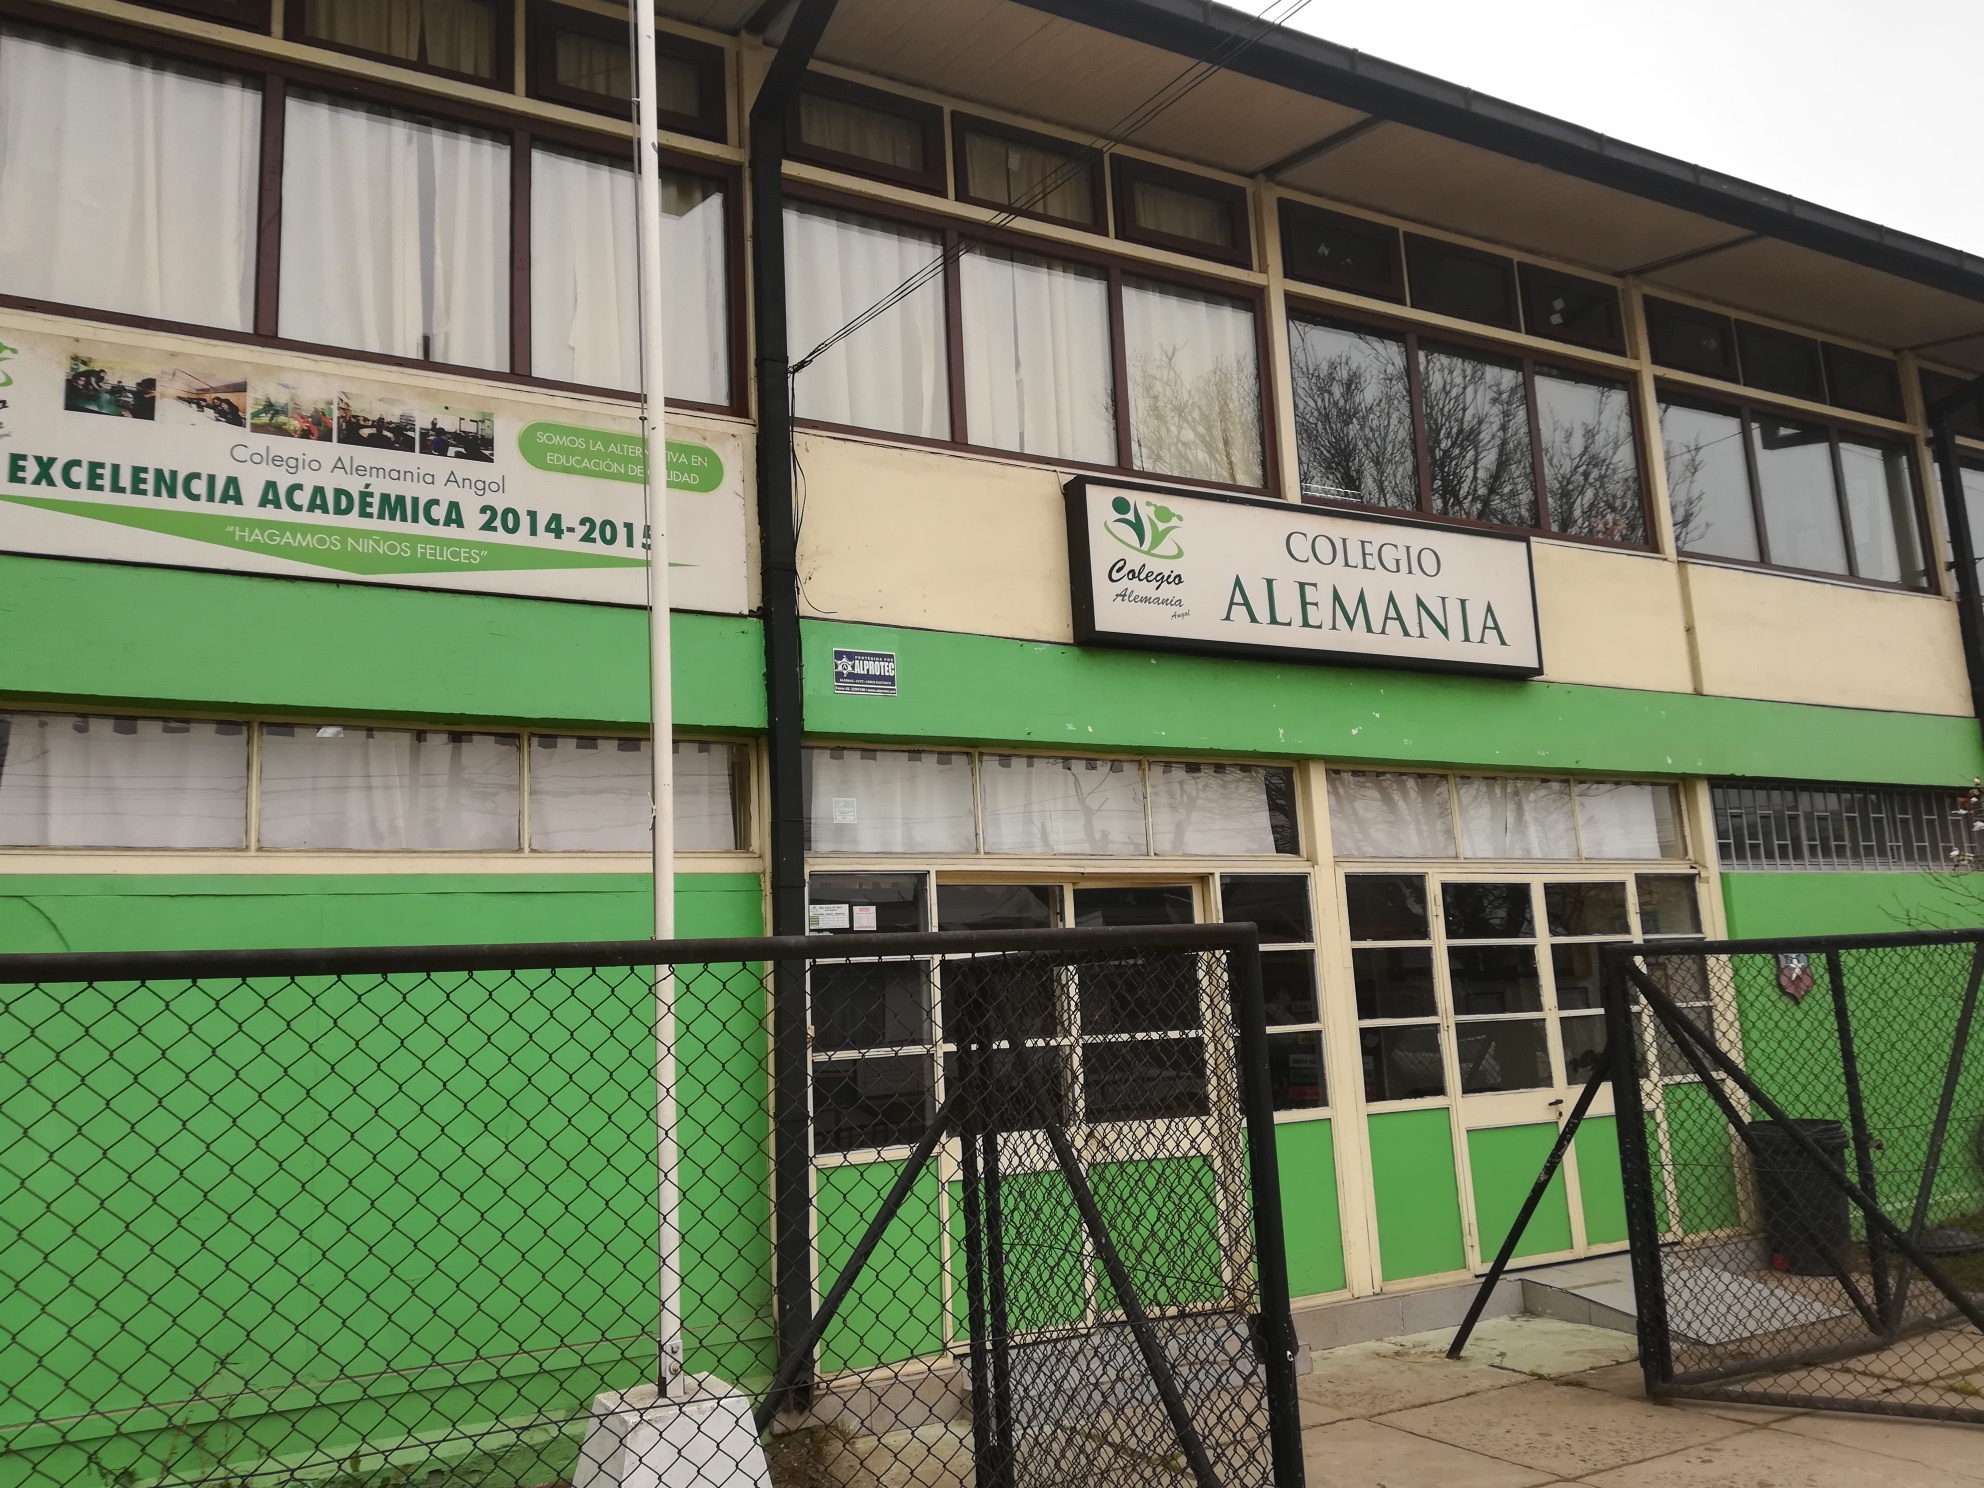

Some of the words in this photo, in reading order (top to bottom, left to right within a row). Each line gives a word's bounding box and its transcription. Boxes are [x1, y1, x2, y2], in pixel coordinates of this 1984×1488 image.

[536, 431, 586, 449] SOMOS
[590, 440, 604, 452] LA
[691, 455, 708, 468] EN
[546, 452, 625, 474] EDUCACIÓN
[628, 465, 644, 477] DE
[229, 443, 323, 475] Colegio
[331, 455, 436, 486] Alemania
[444, 470, 506, 497] Angol
[8, 452, 244, 506] EXCELENCIA
[258, 481, 465, 529] ACADÉMICA
[347, 533, 411, 558] NIÑOS
[1285, 531, 1441, 578] COLEGIO
[1108, 558, 1184, 590] Colegio
[1113, 587, 1184, 607] Alemania
[1220, 574, 1511, 647] ALEMANIA
[1171, 609, 1190, 620] Angol
[855, 660, 895, 676] ALPROTEC
